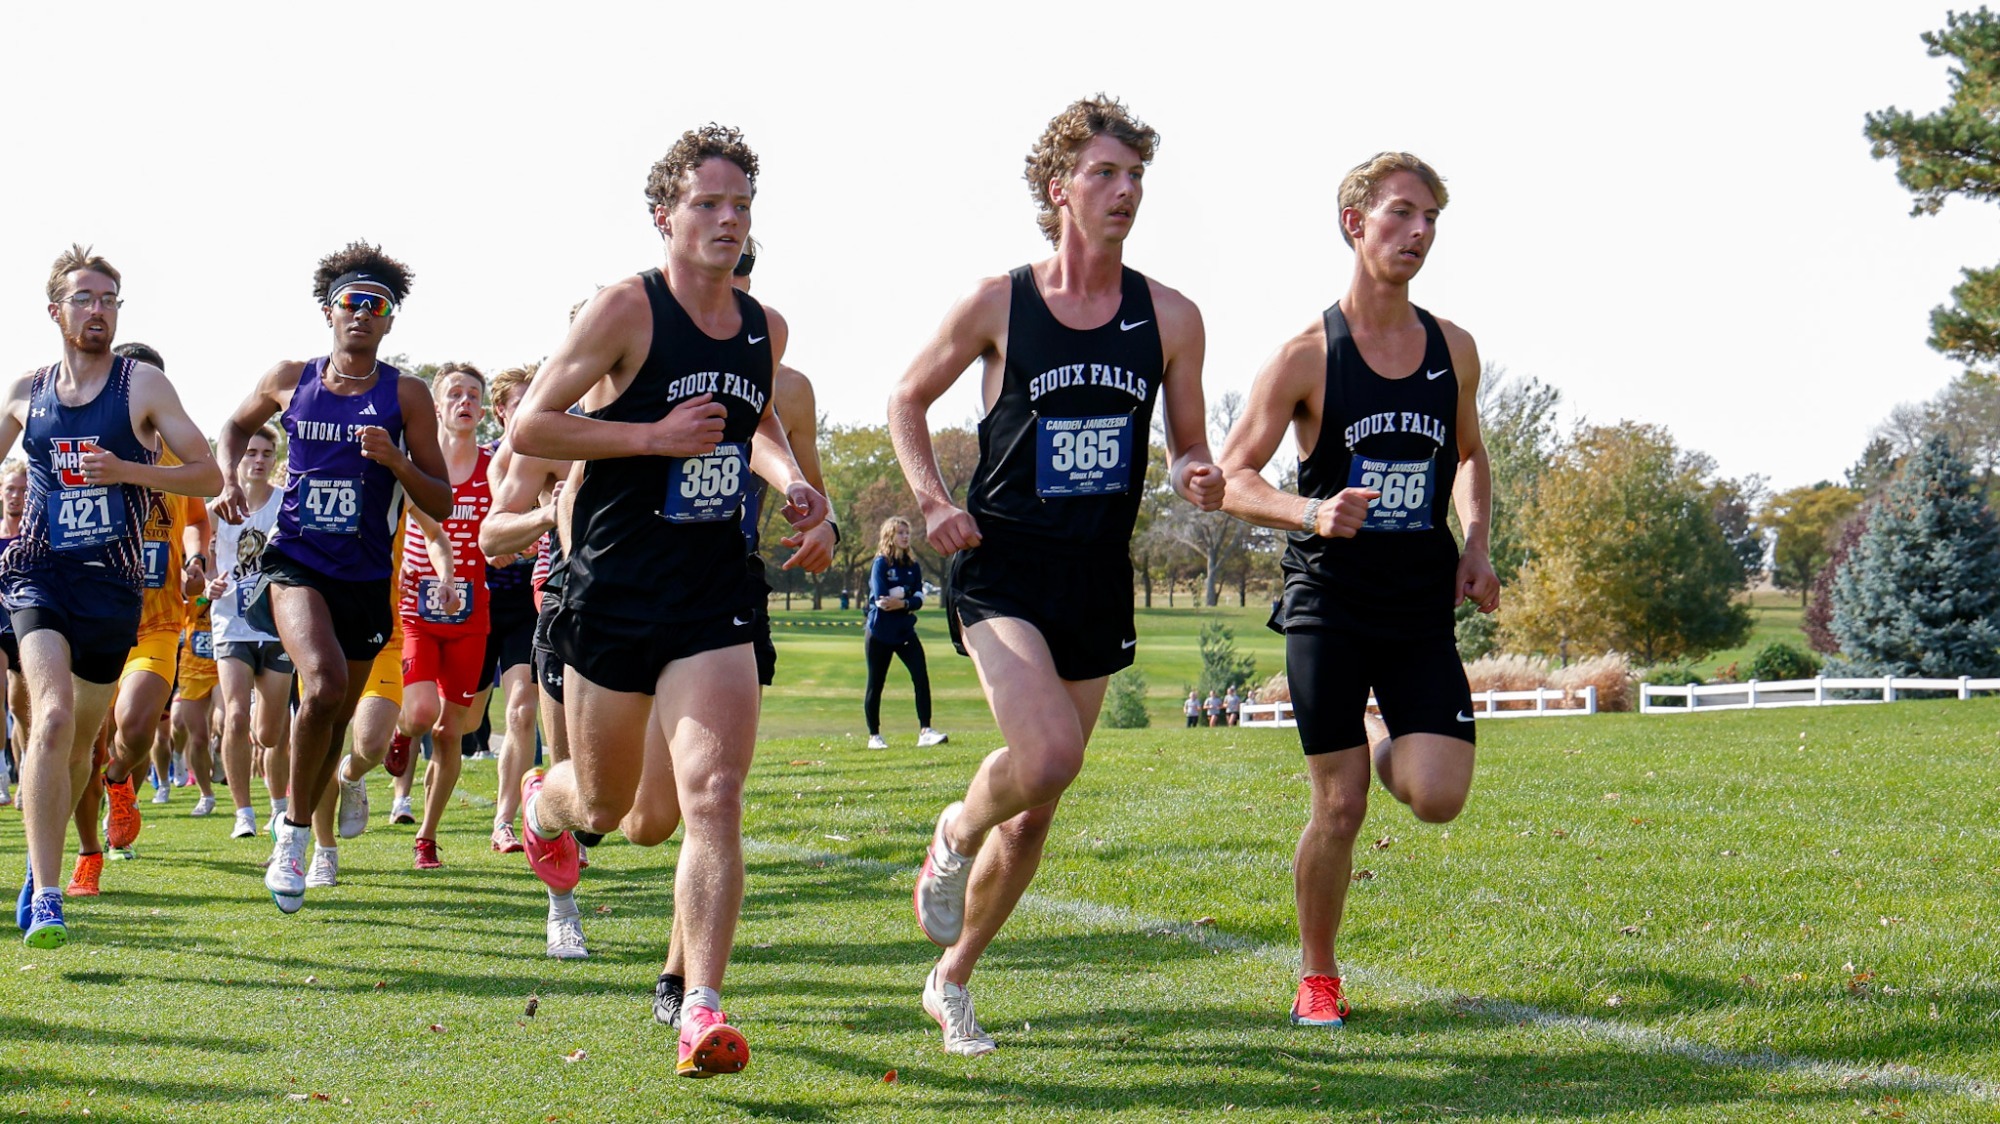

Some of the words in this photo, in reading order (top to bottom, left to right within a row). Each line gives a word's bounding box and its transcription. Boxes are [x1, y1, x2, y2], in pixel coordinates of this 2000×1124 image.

[666, 372, 720, 403] SIOUX
[722, 372, 765, 414] FALLS
[1029, 363, 1085, 402] SIOUX
[1090, 363, 1147, 402] FALLS
[297, 420, 341, 442] WINONA
[1046, 420, 1083, 431] CAMDEN
[1344, 412, 1396, 448] SIOUX
[1400, 412, 1446, 447] FALLS
[1052, 429, 1120, 472] 365
[680, 456, 741, 499] 358
[1069, 471, 1088, 481] Sioux
[1088, 470, 1104, 479] Falls
[1362, 460, 1387, 472] OWEN
[60, 490, 80, 500] CALEB
[81, 487, 108, 498] HANSEN
[309, 479, 332, 488] ROBERT
[333, 480, 353, 488] SPAIN
[1361, 471, 1426, 509] 366
[58, 495, 111, 530] 421
[305, 487, 356, 517] 478
[693, 498, 709, 507] Sioux
[709, 497, 723, 505] Falls
[1373, 509, 1391, 518] Sioux
[1391, 509, 1408, 518] Falls
[426, 588, 466, 611] 36
